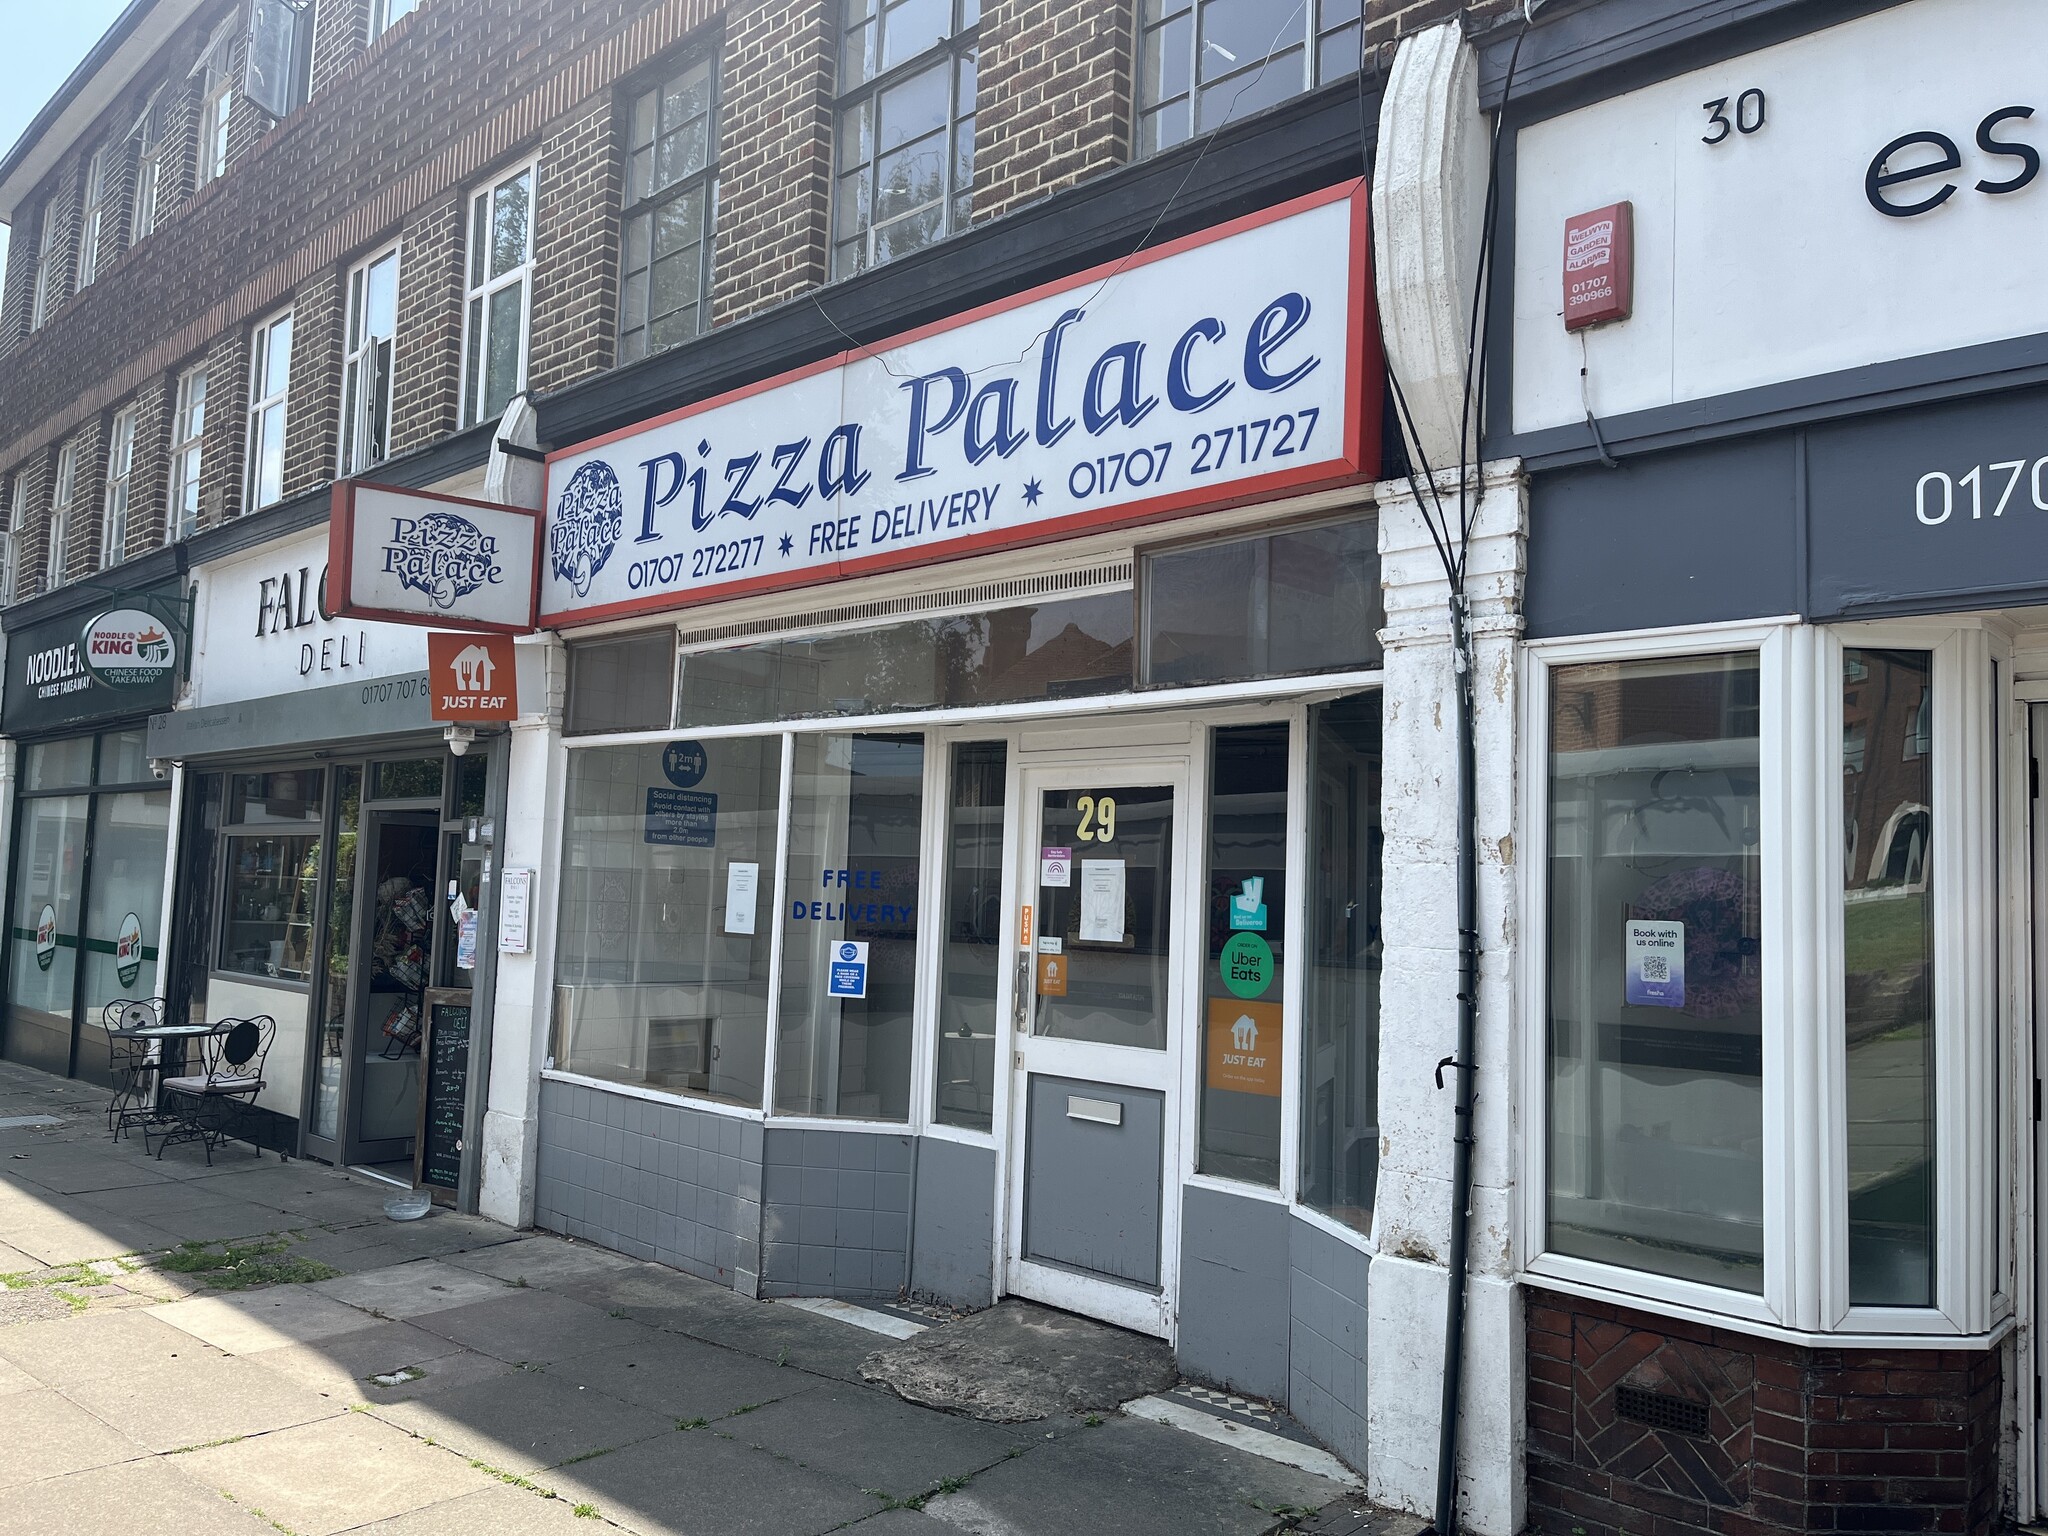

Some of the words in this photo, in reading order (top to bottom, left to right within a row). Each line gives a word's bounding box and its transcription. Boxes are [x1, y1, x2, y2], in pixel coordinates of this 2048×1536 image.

[1701, 87, 1766, 145] 30
[1864, 104, 2042, 218] es
[1571, 222, 1611, 242] WELWYN
[1570, 236, 1608, 256] GARDEN
[1568, 250, 1607, 269] ALARMS
[1572, 276, 1608, 293] 01707
[1569, 286, 1612, 306] 390966
[634, 423, 872, 545] Pizza
[894, 292, 1321, 483] Palace
[558, 484, 623, 522] Pizza
[627, 553, 684, 591] 01707
[692, 536, 764, 579] 272277
[809, 515, 861, 556] FREE
[871, 483, 1001, 545] DELIVERY
[1068, 441, 1173, 499] 01707
[1191, 407, 1320, 476] 271727
[390, 517, 500, 555] Pizza
[552, 515, 623, 556] Palace
[381, 546, 505, 585] Palace
[94, 631, 127, 640] NOODLE
[91, 640, 134, 655] KING
[300, 630, 366, 676] DELI
[26, 642, 76, 686] NOODLE
[104, 668, 138, 677] CHINESE
[139, 668, 163, 676] FOOD
[38, 683, 60, 699] CHINESE
[60, 676, 91, 696] TAKEAWAY
[110, 676, 156, 684] TAKEAWAY
[361, 681, 393, 705] 01707
[396, 678, 418, 699] 707
[441, 696, 478, 711] JUST
[481, 696, 507, 709] EAT
[158, 714, 167, 730] 28
[678, 753, 693, 764] 2m
[653, 790, 676, 800] Social
[676, 793, 712, 805] distancing
[653, 803, 672, 811] Avoid
[672, 804, 697, 812] contact
[676, 812, 684, 820] by
[686, 813, 709, 822] staying
[683, 819, 698, 827] than
[1076, 796, 1116, 843] 29
[652, 832, 667, 840] from
[668, 833, 685, 841] other
[822, 869, 882, 890] FREE
[792, 900, 913, 923] DELIVERY
[1633, 928, 1656, 937] Book
[1657, 930, 1678, 938] with
[1647, 938, 1675, 948] online
[1231, 951, 1262, 967] Uber
[1231, 967, 1261, 982] Eats
[1222, 1053, 1246, 1065] JUST
[1247, 1056, 1267, 1068] EAT
